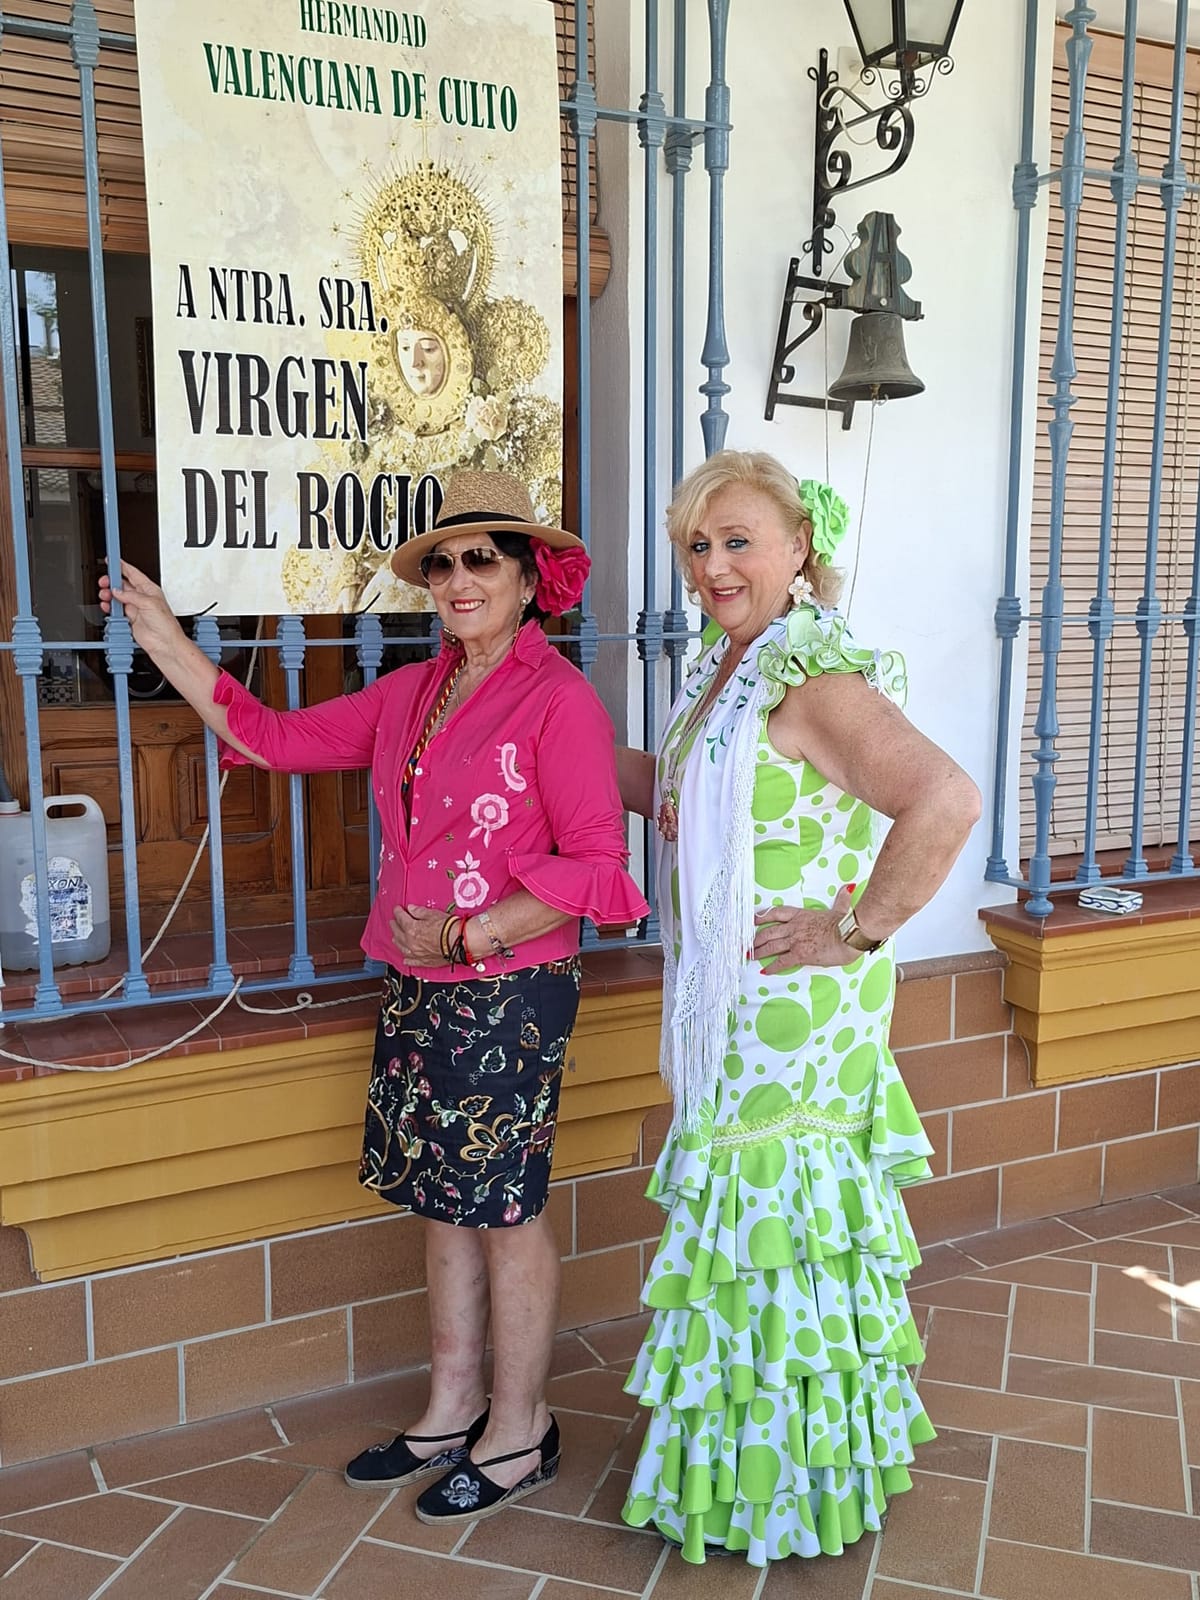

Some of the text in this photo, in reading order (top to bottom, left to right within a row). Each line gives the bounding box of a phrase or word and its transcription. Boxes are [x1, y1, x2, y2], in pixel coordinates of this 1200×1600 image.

[300, 0, 427, 48] HERMANDAD
[203, 43, 517, 132] VALENCIANA DE CULTO
[177, 264, 388, 334] A NTRA. SRA.
[178, 350, 368, 440] VIRGEN
[182, 468, 444, 551] DEL ROCIO
